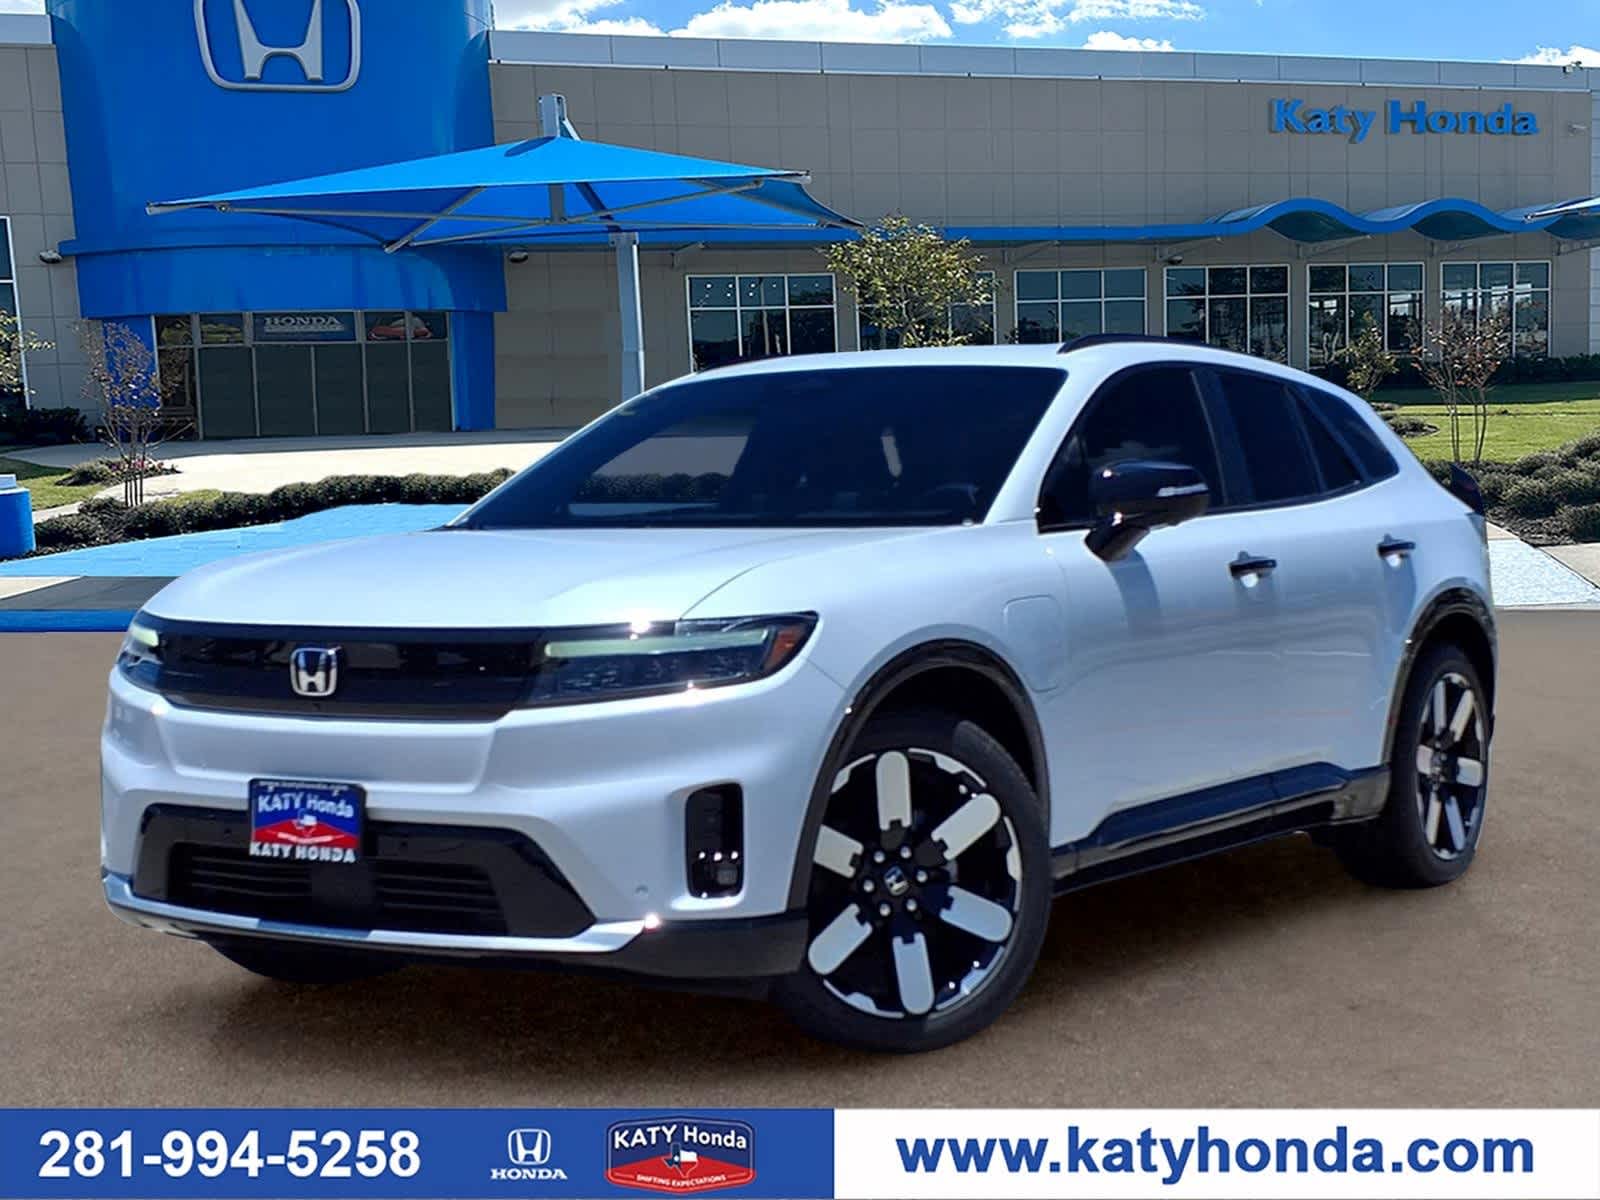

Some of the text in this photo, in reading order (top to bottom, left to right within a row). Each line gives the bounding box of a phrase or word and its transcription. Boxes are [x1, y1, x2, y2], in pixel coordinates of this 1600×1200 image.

[1268, 98, 1540, 143] Katy Honda
[264, 316, 342, 328] HONDA
[258, 792, 354, 818] KATY Honda
[249, 842, 356, 863] KATY HONDA
